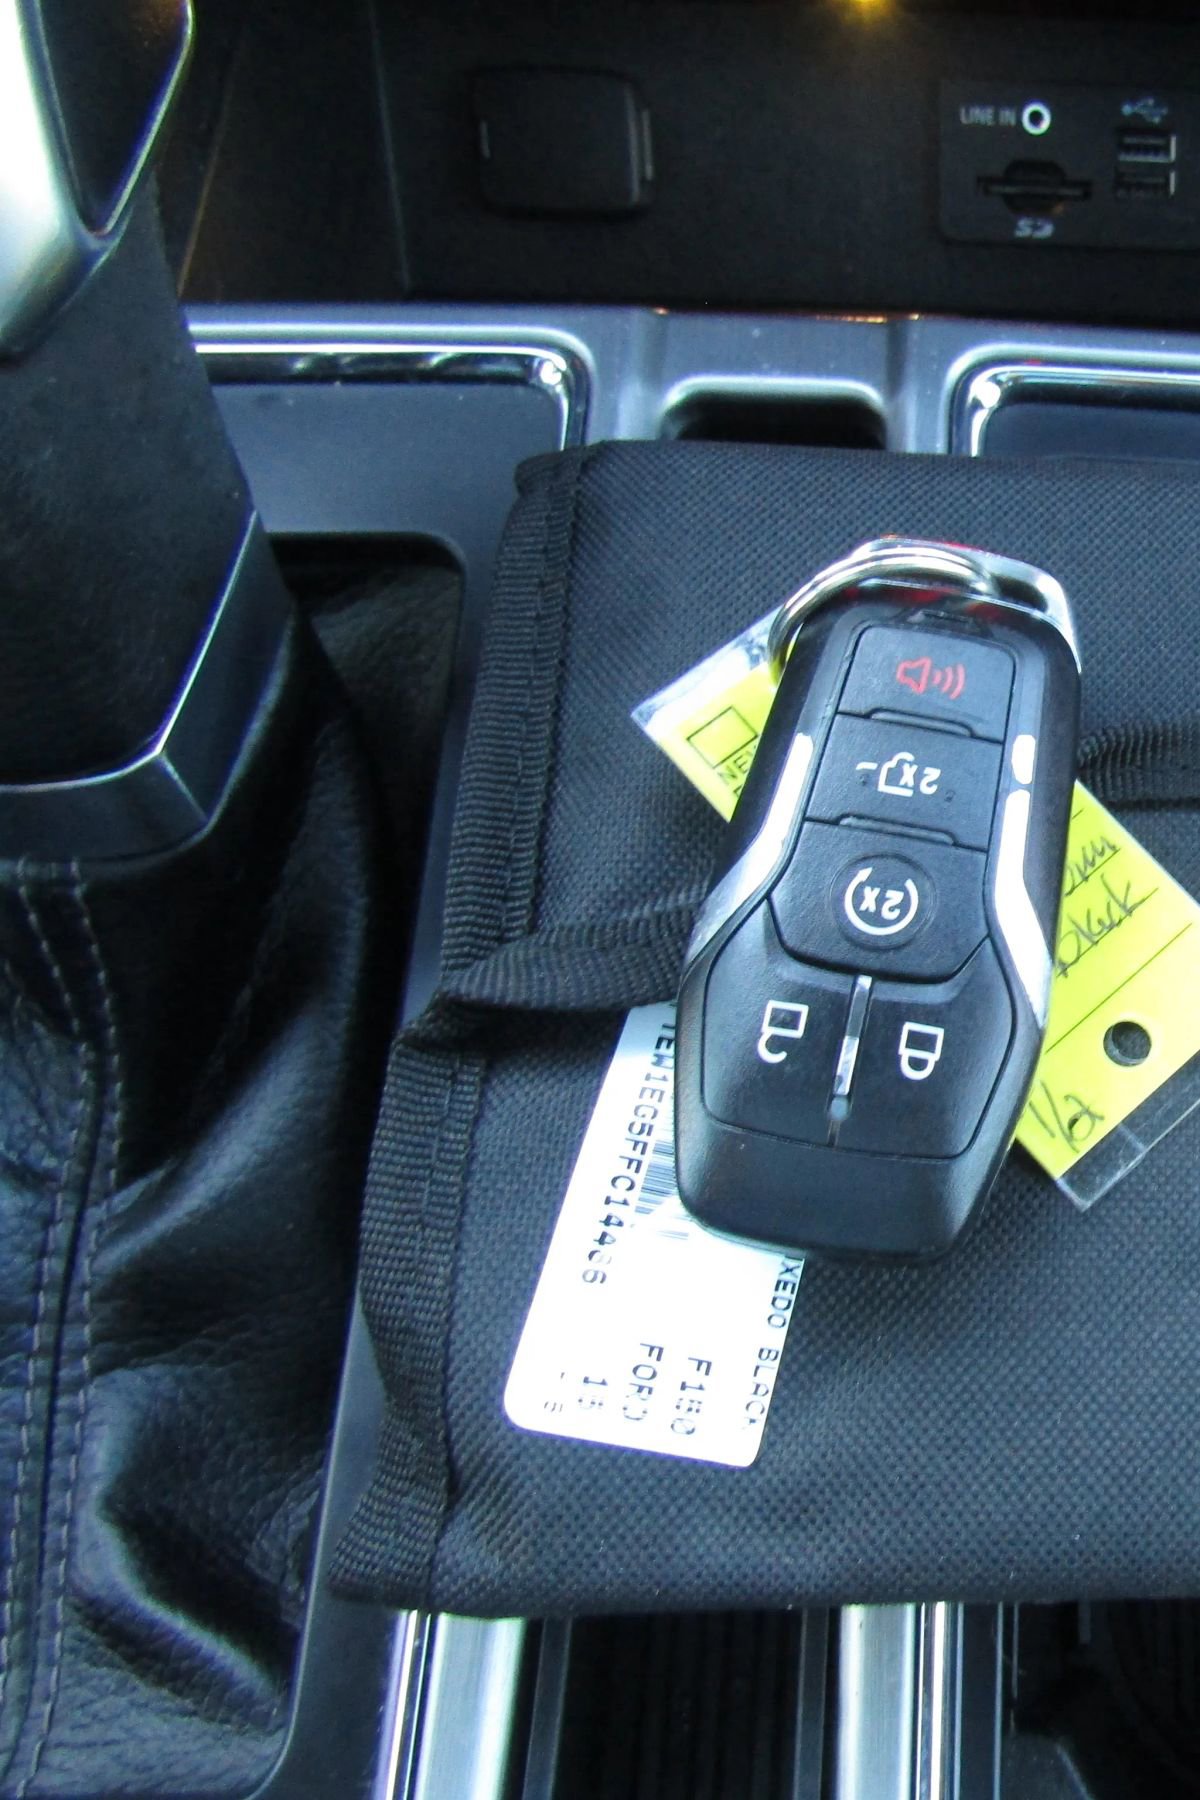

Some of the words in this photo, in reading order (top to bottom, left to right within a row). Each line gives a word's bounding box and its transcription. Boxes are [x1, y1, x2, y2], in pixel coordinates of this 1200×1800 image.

[959, 105, 994, 125] LINE
[999, 106, 1017, 126] IN
[767, 1256, 803, 1330] XEDO
[622, 1343, 664, 1421] FORD
